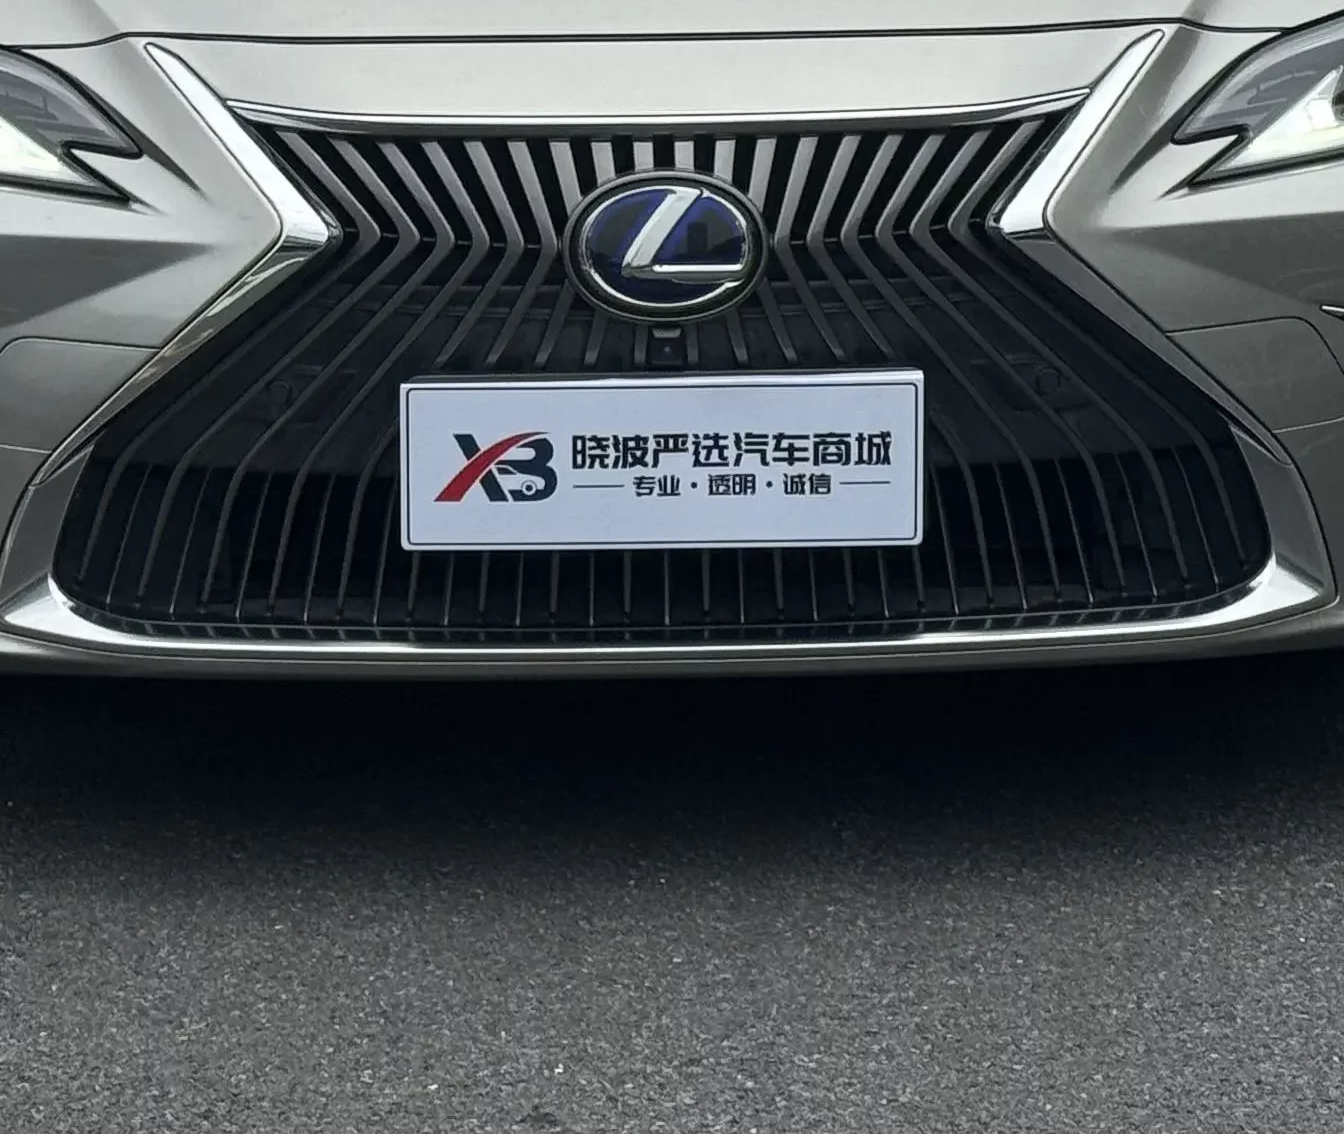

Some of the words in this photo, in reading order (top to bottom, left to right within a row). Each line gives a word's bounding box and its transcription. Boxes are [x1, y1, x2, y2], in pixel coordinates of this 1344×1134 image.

[570, 429, 893, 469] 晓波严选汽车商城
